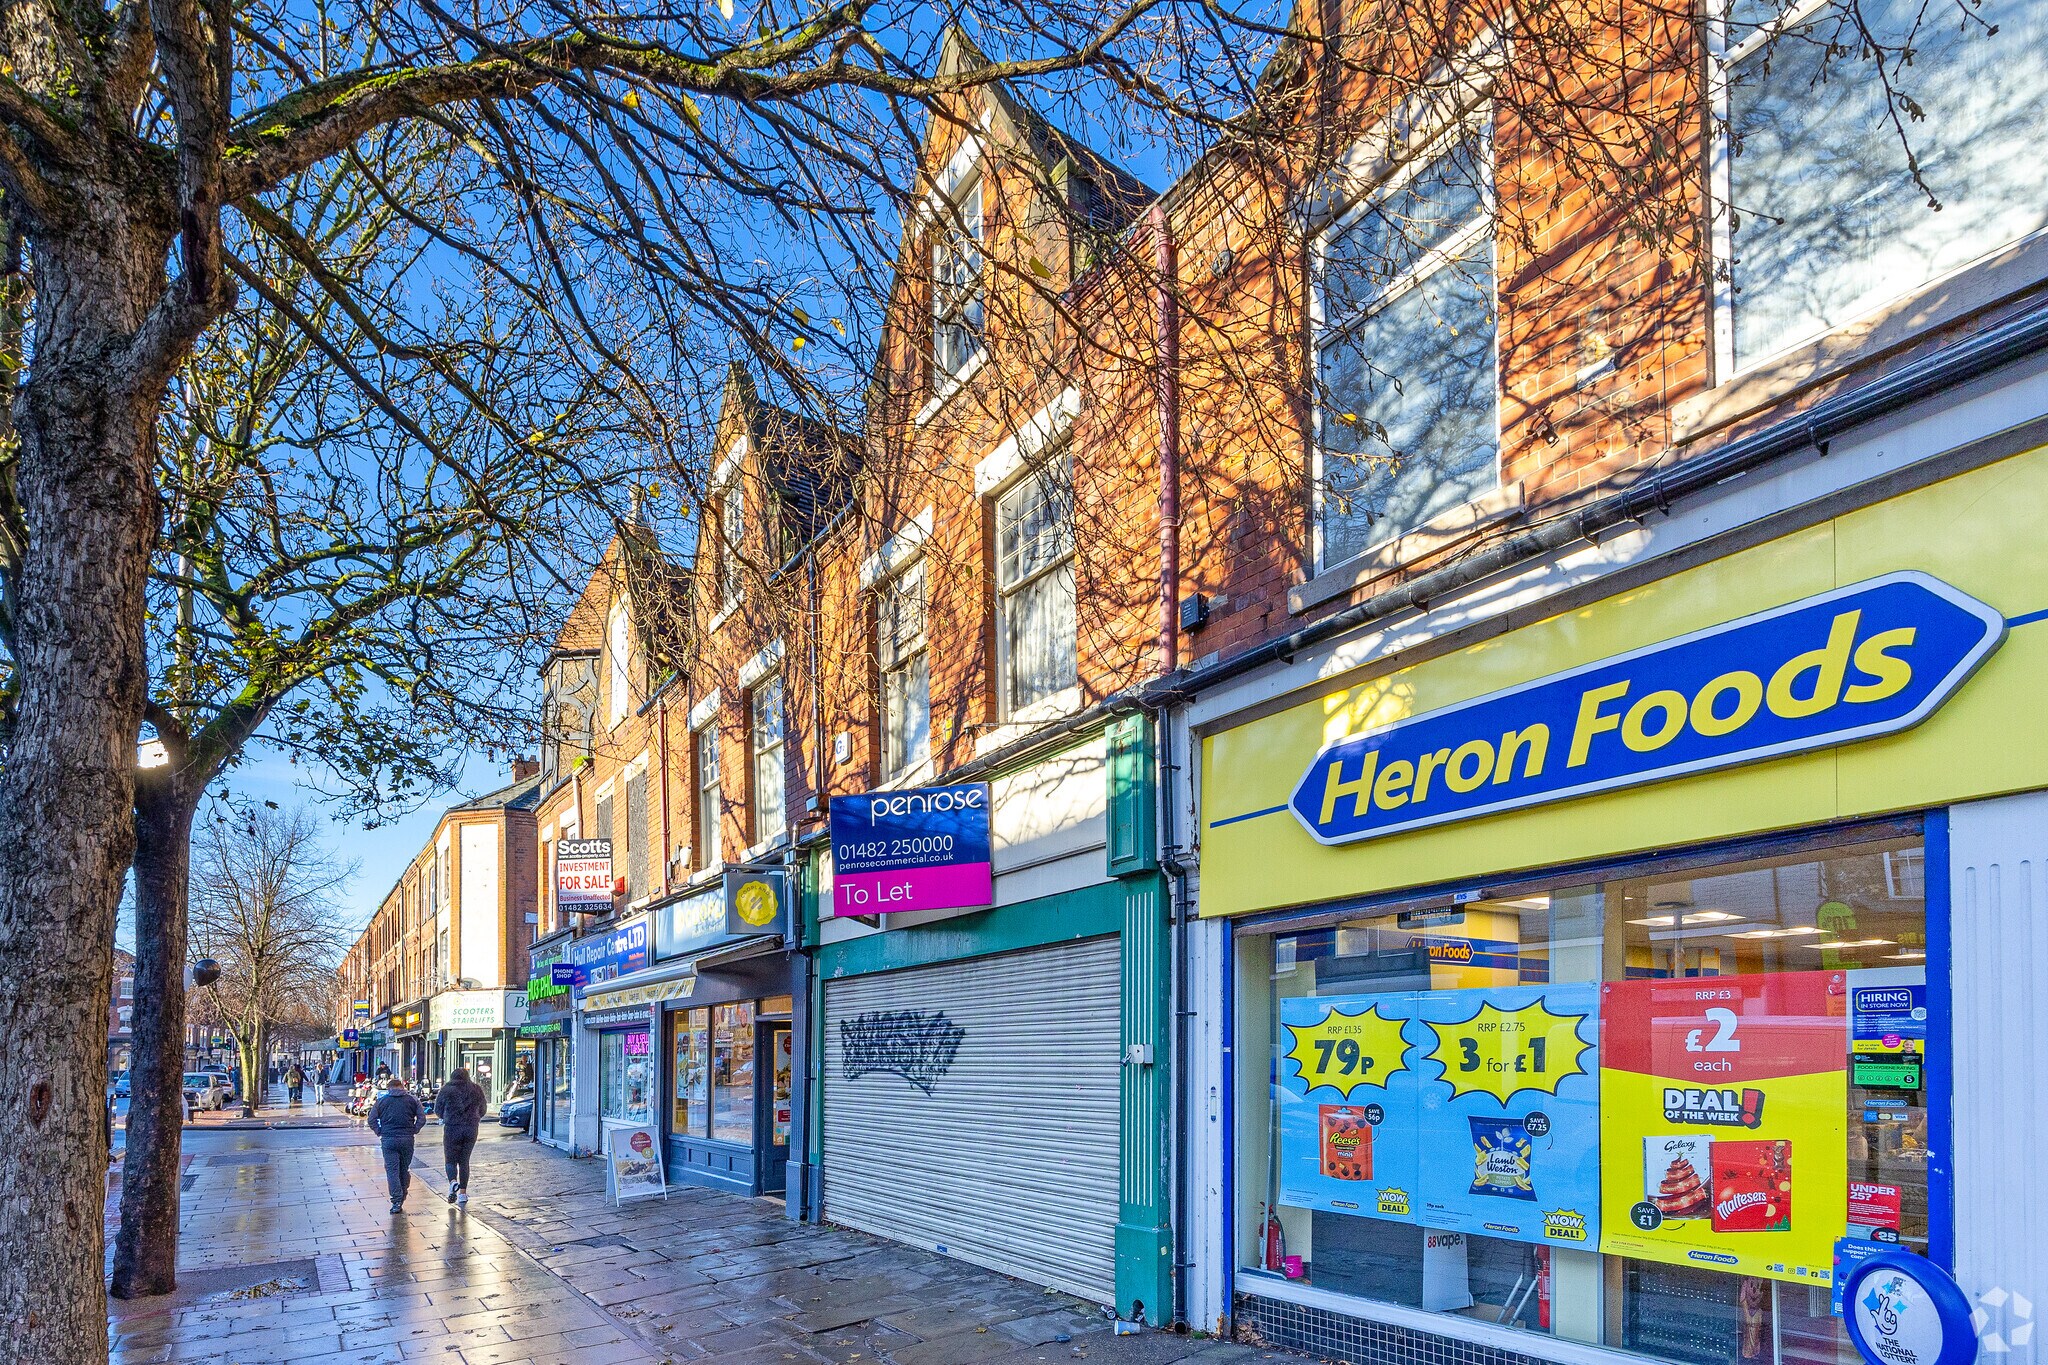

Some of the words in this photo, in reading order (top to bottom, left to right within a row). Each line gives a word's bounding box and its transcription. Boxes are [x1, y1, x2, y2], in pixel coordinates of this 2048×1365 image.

[1319, 720, 1550, 825] Heron
[1567, 608, 1916, 768] Foods
[870, 789, 983, 827] penrose
[558, 840, 611, 855] Scotts
[839, 841, 887, 860] 01482
[891, 835, 953, 856] 250000
[559, 862, 609, 872] INVESTMENT
[839, 852, 954, 872] penrosecommercial.co.uk
[559, 876, 581, 890] FOR
[584, 875, 610, 889] SALE
[583, 893, 610, 901] Unaffected
[840, 883, 868, 905] To
[877, 881, 913, 902] Let
[559, 904, 582, 912] 01482
[584, 903, 612, 911] 325634
[574, 947, 586, 967] Hull
[586, 942, 606, 965] Repair
[607, 936, 628, 957] Centre
[627, 925, 645, 950] LTD
[1443, 944, 1470, 959] Foods
[1695, 991, 1716, 1000] RRP
[1719, 990, 1731, 999] £3
[1861, 992, 1908, 1002] HIRING
[453, 1007, 494, 1015] SCOOTERS
[452, 1016, 495, 1024] STAIRLIFTS
[1327, 1026, 1342, 1034] RRP
[1477, 1022, 1497, 1032] RRP
[1500, 1022, 1525, 1032] £2.75
[1684, 1007, 1741, 1052] £2
[1458, 1037, 1481, 1072] 3
[1486, 1057, 1509, 1072] for
[1514, 1036, 1546, 1073] £1
[1694, 1058, 1732, 1072] each
[1905, 1075, 1913, 1083] 5
[1664, 1110, 1680, 1119] OF
[1682, 1110, 1705, 1120] THE
[1706, 1111, 1739, 1122] WEEK
[1527, 1123, 1547, 1132] £7.25
[1664, 1139, 1697, 1152] Galaxy
[1337, 1150, 1353, 1158] minis
[1490, 1153, 1516, 1165] Lamb
[1486, 1161, 1518, 1174] Weston
[1850, 1183, 1896, 1196] UNDER
[1380, 1192, 1406, 1204] WOW
[1849, 1191, 1872, 1201] 25?
[1381, 1203, 1404, 1213] DEAL!
[1637, 1206, 1655, 1215] SAVE
[1716, 1191, 1767, 1220] Maltesers
[1547, 1214, 1582, 1228] WOW
[1639, 1214, 1653, 1226] £1
[1484, 1223, 1501, 1231] Heron
[1501, 1225, 1518, 1233] Foods
[1550, 1228, 1580, 1238] DEAL!
[1690, 1251, 1712, 1261] Heron
[1713, 1254, 1736, 1264] Foods
[1842, 1248, 1867, 1256] support
[1883, 1337, 1900, 1348] THE
[1875, 1342, 1918, 1358] NATIONAL
[1880, 1349, 1917, 1365] LOTTERY
